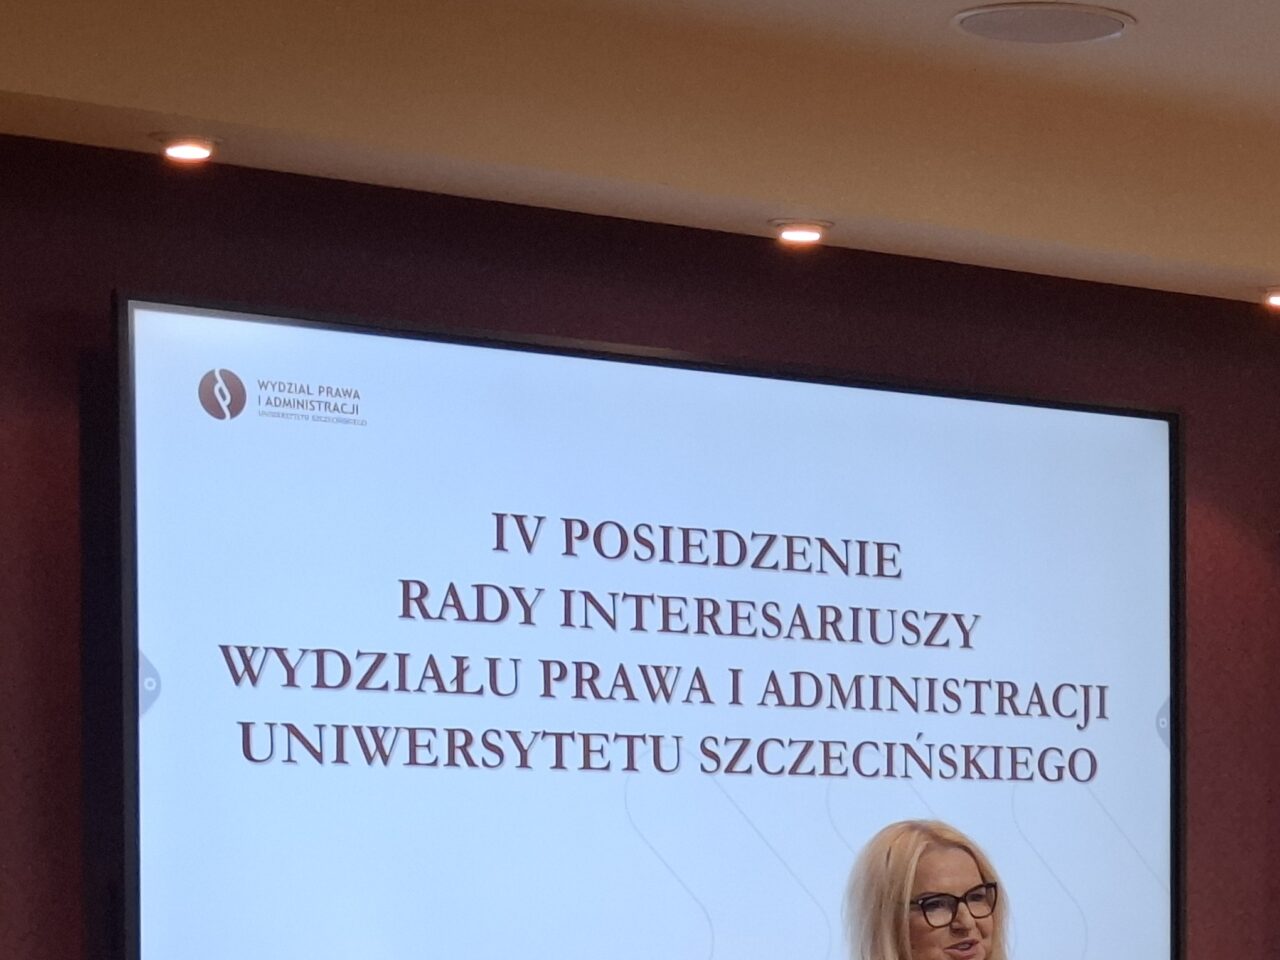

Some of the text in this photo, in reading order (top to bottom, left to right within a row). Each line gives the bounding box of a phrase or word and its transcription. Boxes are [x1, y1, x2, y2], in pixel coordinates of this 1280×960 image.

[265, 396, 359, 415] ADMINISTRACJI
[318, 385, 361, 400] PRAWA
[491, 512, 902, 580] IV POSIEDZENIE
[398, 579, 981, 650] RADY INTERESARIUSZY
[218, 644, 1110, 731] WYDZIAŁU PRAWA I ADMINISTRACJI
[236, 721, 1098, 783] UNIWERSYTETU SZCZECIŃSKIEGO
